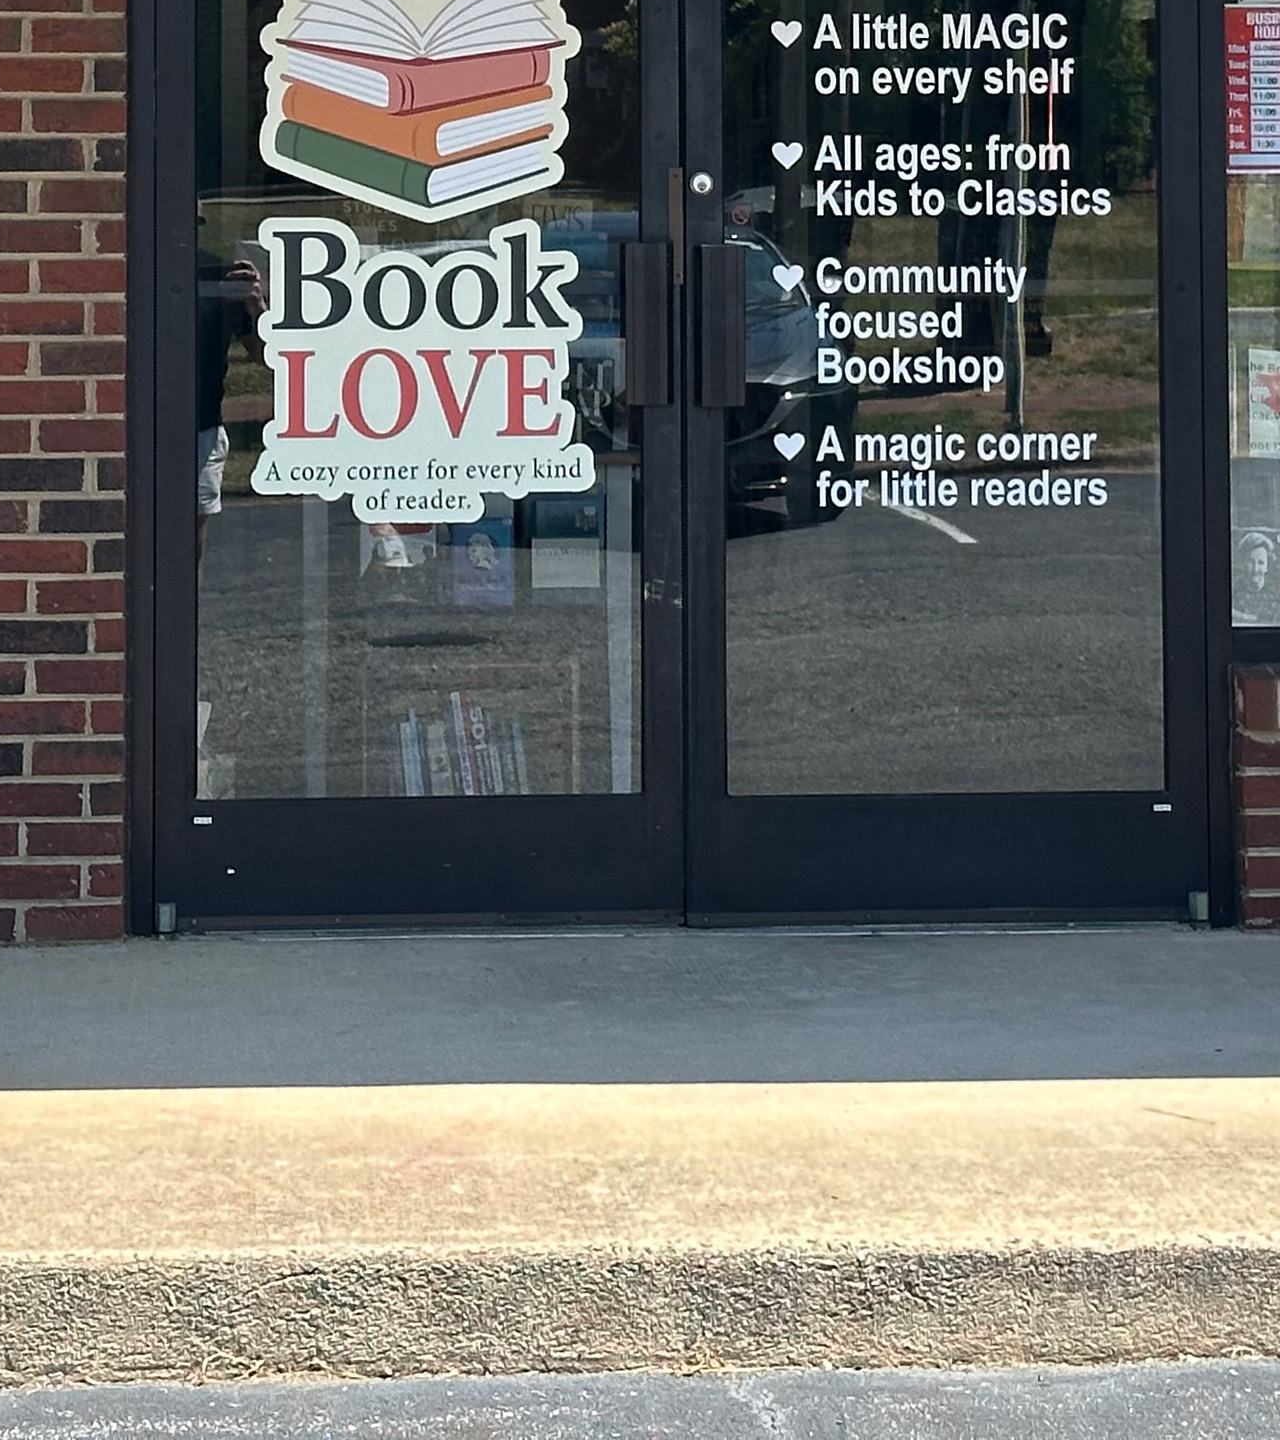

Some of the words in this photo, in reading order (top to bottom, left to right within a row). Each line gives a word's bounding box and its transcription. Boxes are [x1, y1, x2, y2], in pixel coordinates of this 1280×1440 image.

[813, 14, 842, 50] A
[852, 14, 930, 50] little
[942, 13, 1069, 50] MAGIC
[815, 67, 859, 95] on
[872, 66, 972, 104] every
[983, 58, 1075, 95] shelf
[814, 135, 862, 171] All
[875, 144, 973, 180] ages:
[986, 135, 1070, 171] from
[816, 180, 898, 216] Kids
[909, 183, 945, 216] to
[957, 179, 1112, 216] Classics
[271, 230, 570, 331] Book
[815, 257, 1027, 302] Community
[815, 302, 963, 339] focused
[817, 347, 1005, 392] Bookshop
[277, 349, 561, 440] LOVE
[816, 425, 845, 462] A
[855, 425, 965, 470] magic
[977, 432, 1097, 462] corner
[265, 462, 282, 481] A
[290, 465, 338, 488] cozy
[347, 466, 419, 482] corner
[426, 459, 459, 481] for
[465, 464, 526, 487] every
[533, 458, 582, 479] kind
[816, 470, 869, 507] for
[880, 470, 958, 507] little
[970, 470, 1108, 507] readers
[366, 489, 390, 510] of
[395, 489, 473, 510] reader.
